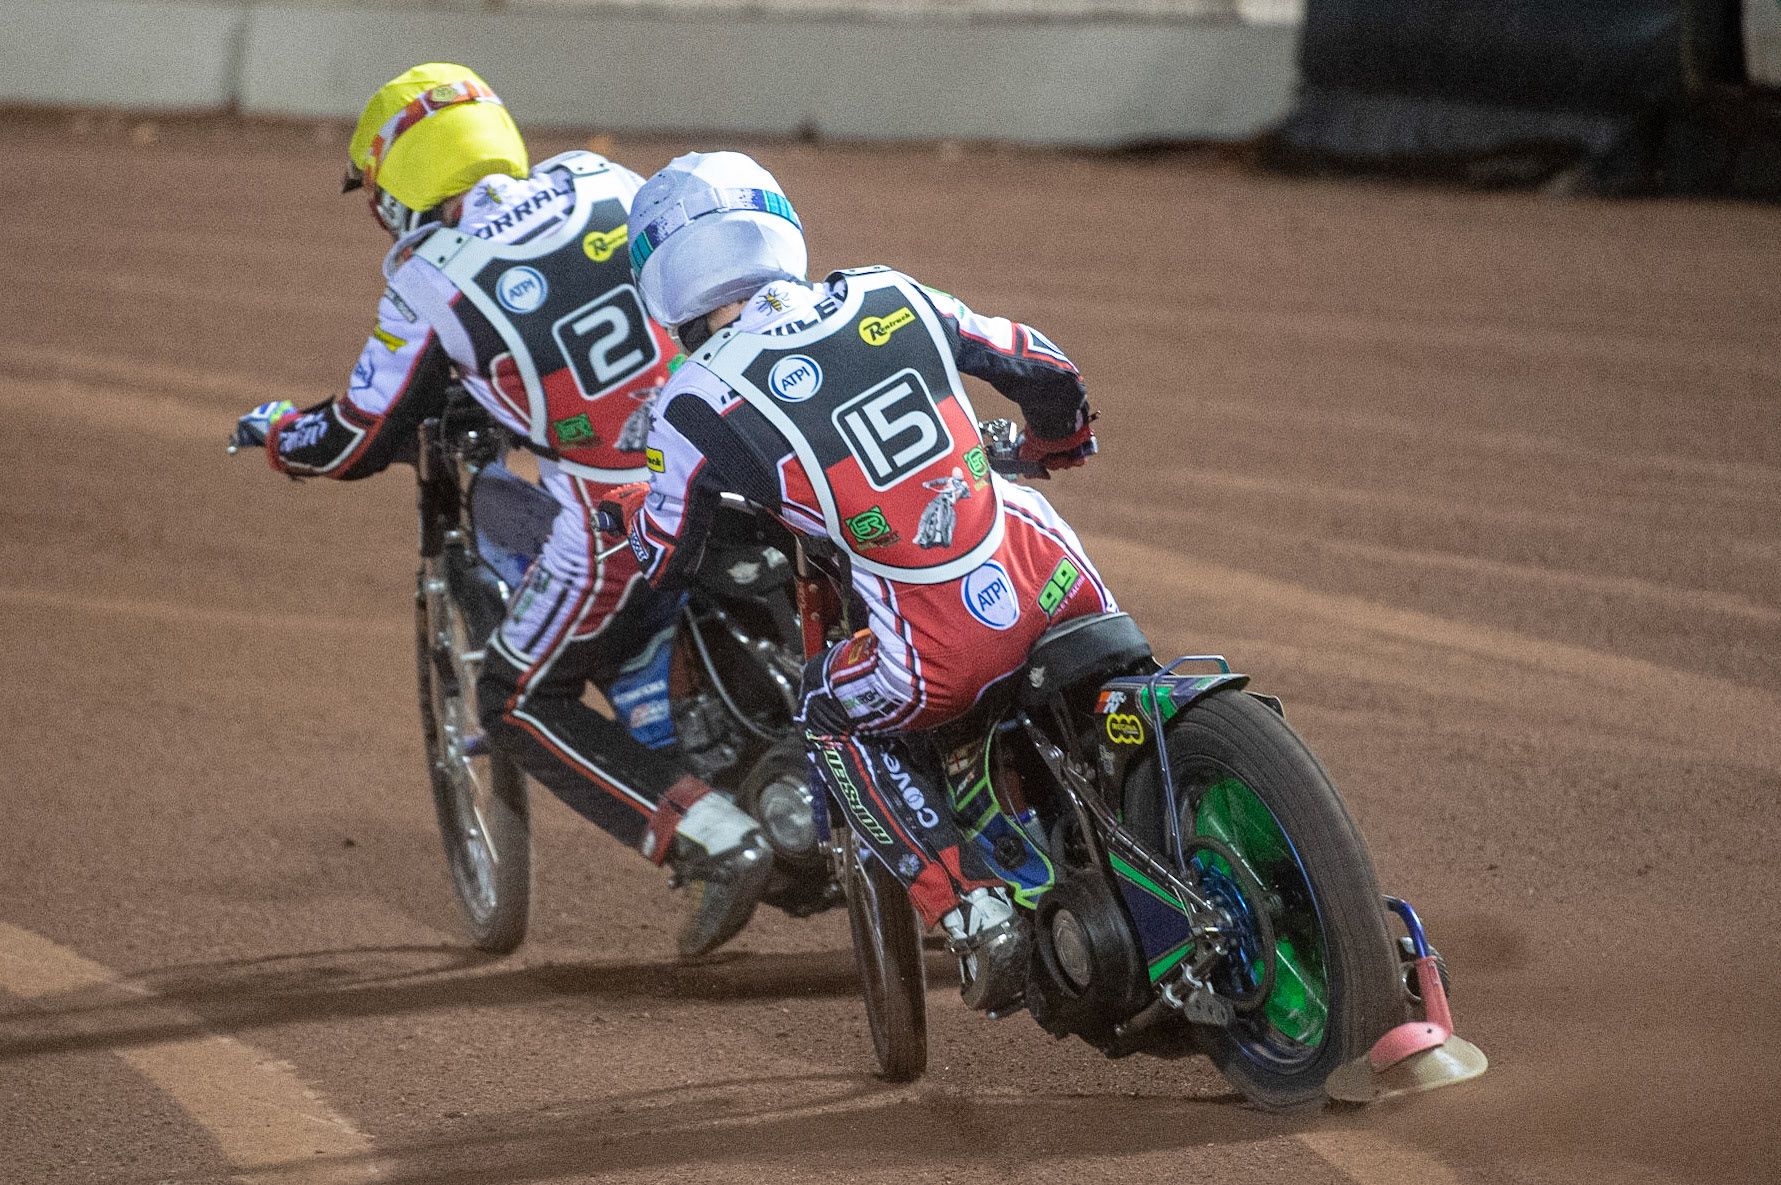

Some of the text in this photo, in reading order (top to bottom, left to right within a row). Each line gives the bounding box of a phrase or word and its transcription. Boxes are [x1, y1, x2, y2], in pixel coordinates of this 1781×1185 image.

[508, 278, 536, 300] ATPI
[572, 305, 644, 383] 2
[863, 312, 911, 342] Rentruck
[781, 366, 811, 391] ATPI
[844, 381, 938, 478] 15
[976, 577, 1008, 612] ATPI
[1038, 556, 1079, 616] 99
